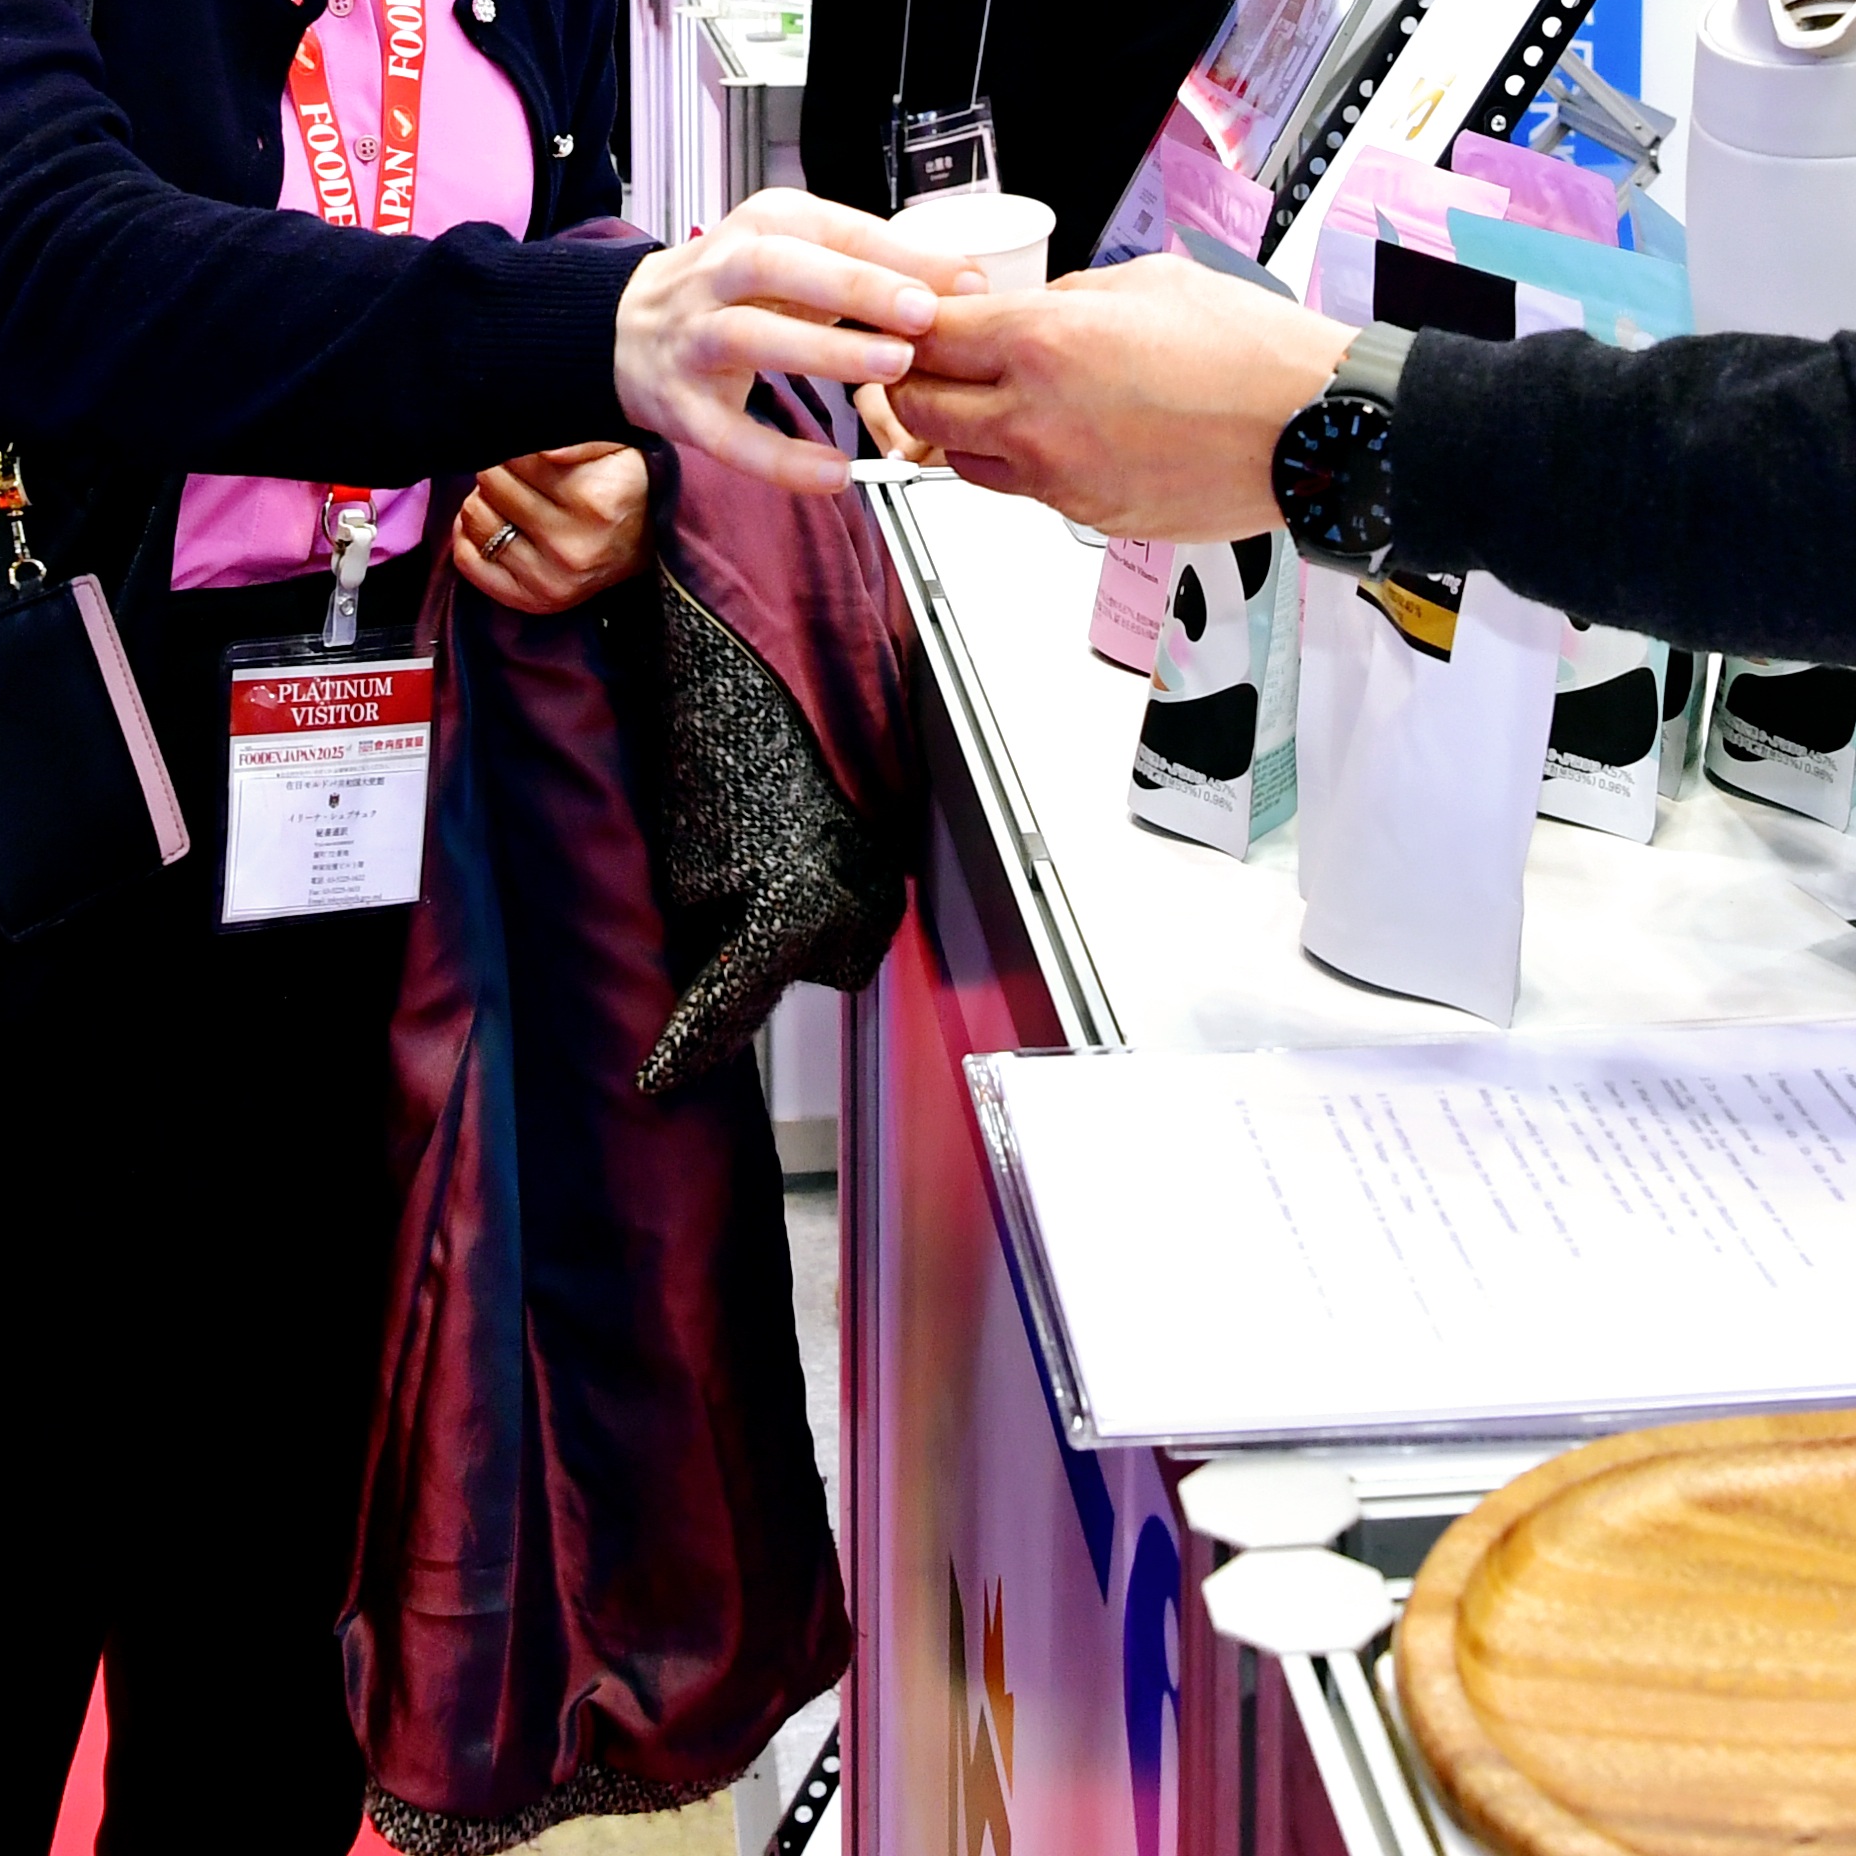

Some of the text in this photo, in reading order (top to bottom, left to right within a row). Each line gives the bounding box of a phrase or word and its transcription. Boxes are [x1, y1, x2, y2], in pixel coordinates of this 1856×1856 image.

[276, 676, 394, 704] PLATINUM
[290, 702, 380, 727] VISITOR
[239, 750, 283, 766] FOODEX
[282, 748, 317, 764] JAPAN
[317, 746, 344, 761] 2025
